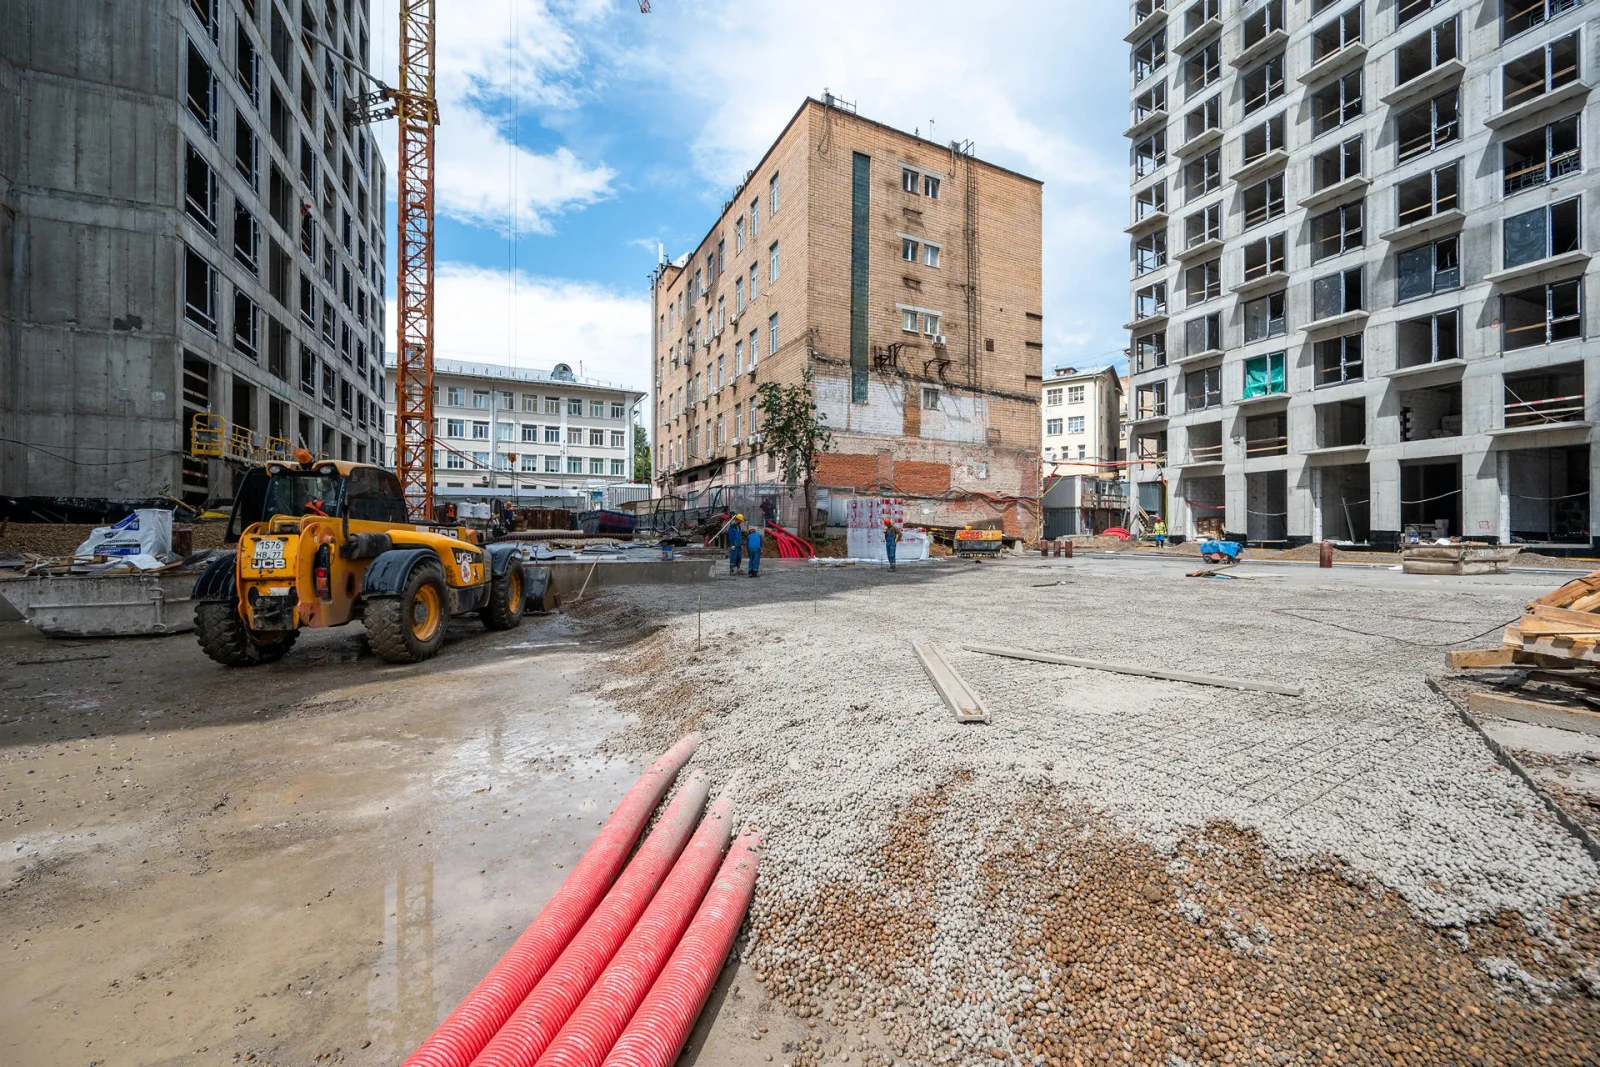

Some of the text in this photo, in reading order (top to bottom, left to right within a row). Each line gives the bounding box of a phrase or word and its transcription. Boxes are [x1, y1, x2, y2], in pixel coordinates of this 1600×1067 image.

[260, 541, 281, 549] 1576
[455, 552, 473, 563] JCB
[251, 559, 286, 568] JCB
